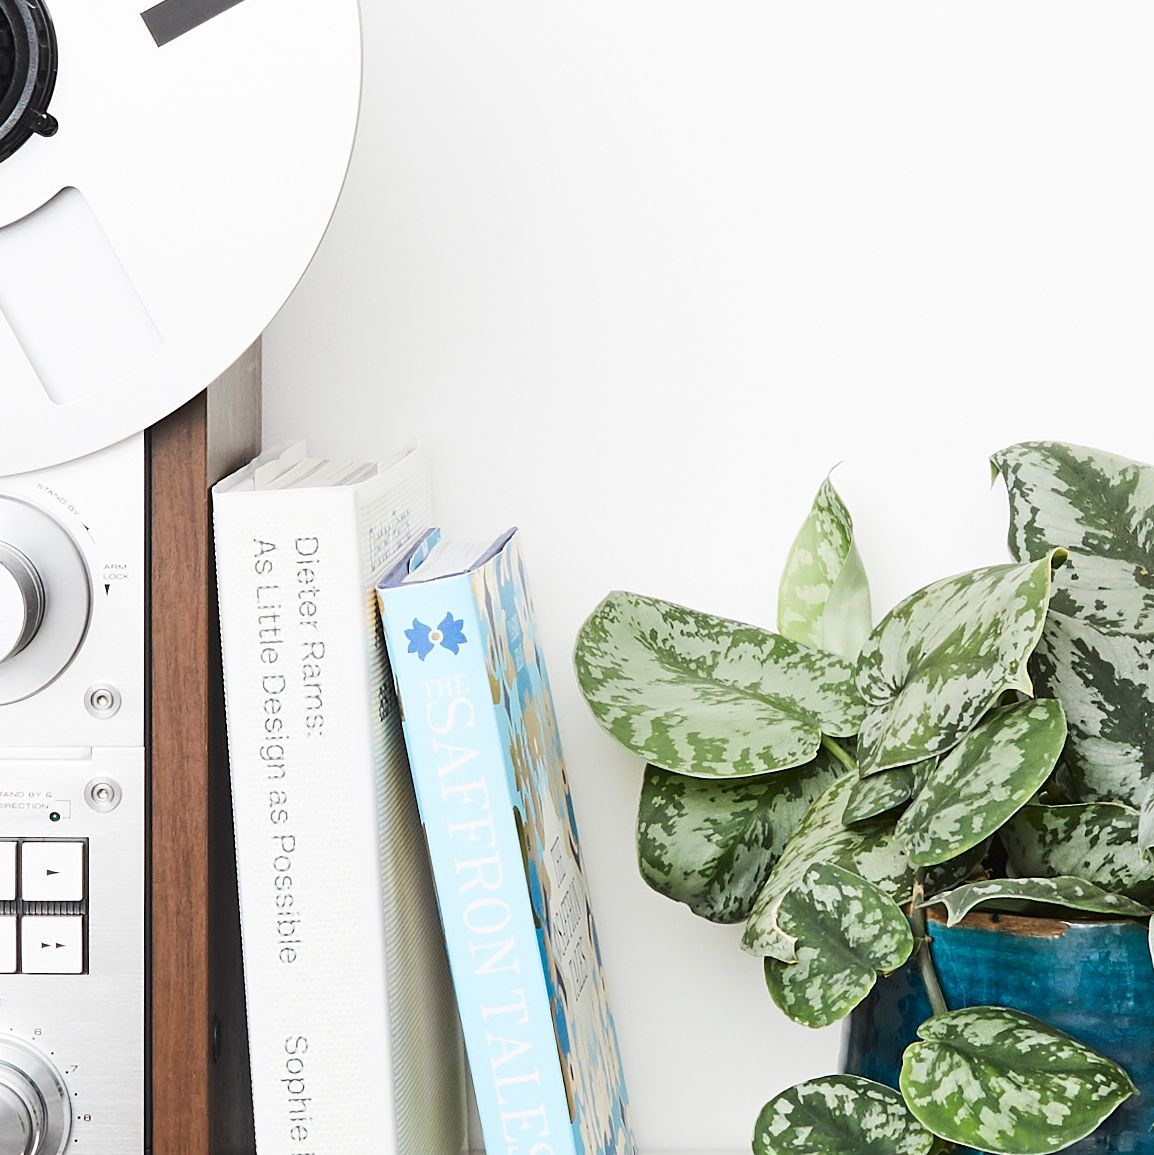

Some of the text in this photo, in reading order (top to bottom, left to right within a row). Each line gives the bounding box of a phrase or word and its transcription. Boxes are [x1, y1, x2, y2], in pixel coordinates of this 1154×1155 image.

[295, 537, 325, 736] Dieter Rams:
[421, 672, 470, 698] THE
[253, 538, 303, 963] As Little Design as Possible
[426, 696, 520, 976] SAFFRON
[281, 1036, 312, 1141] Sophie
